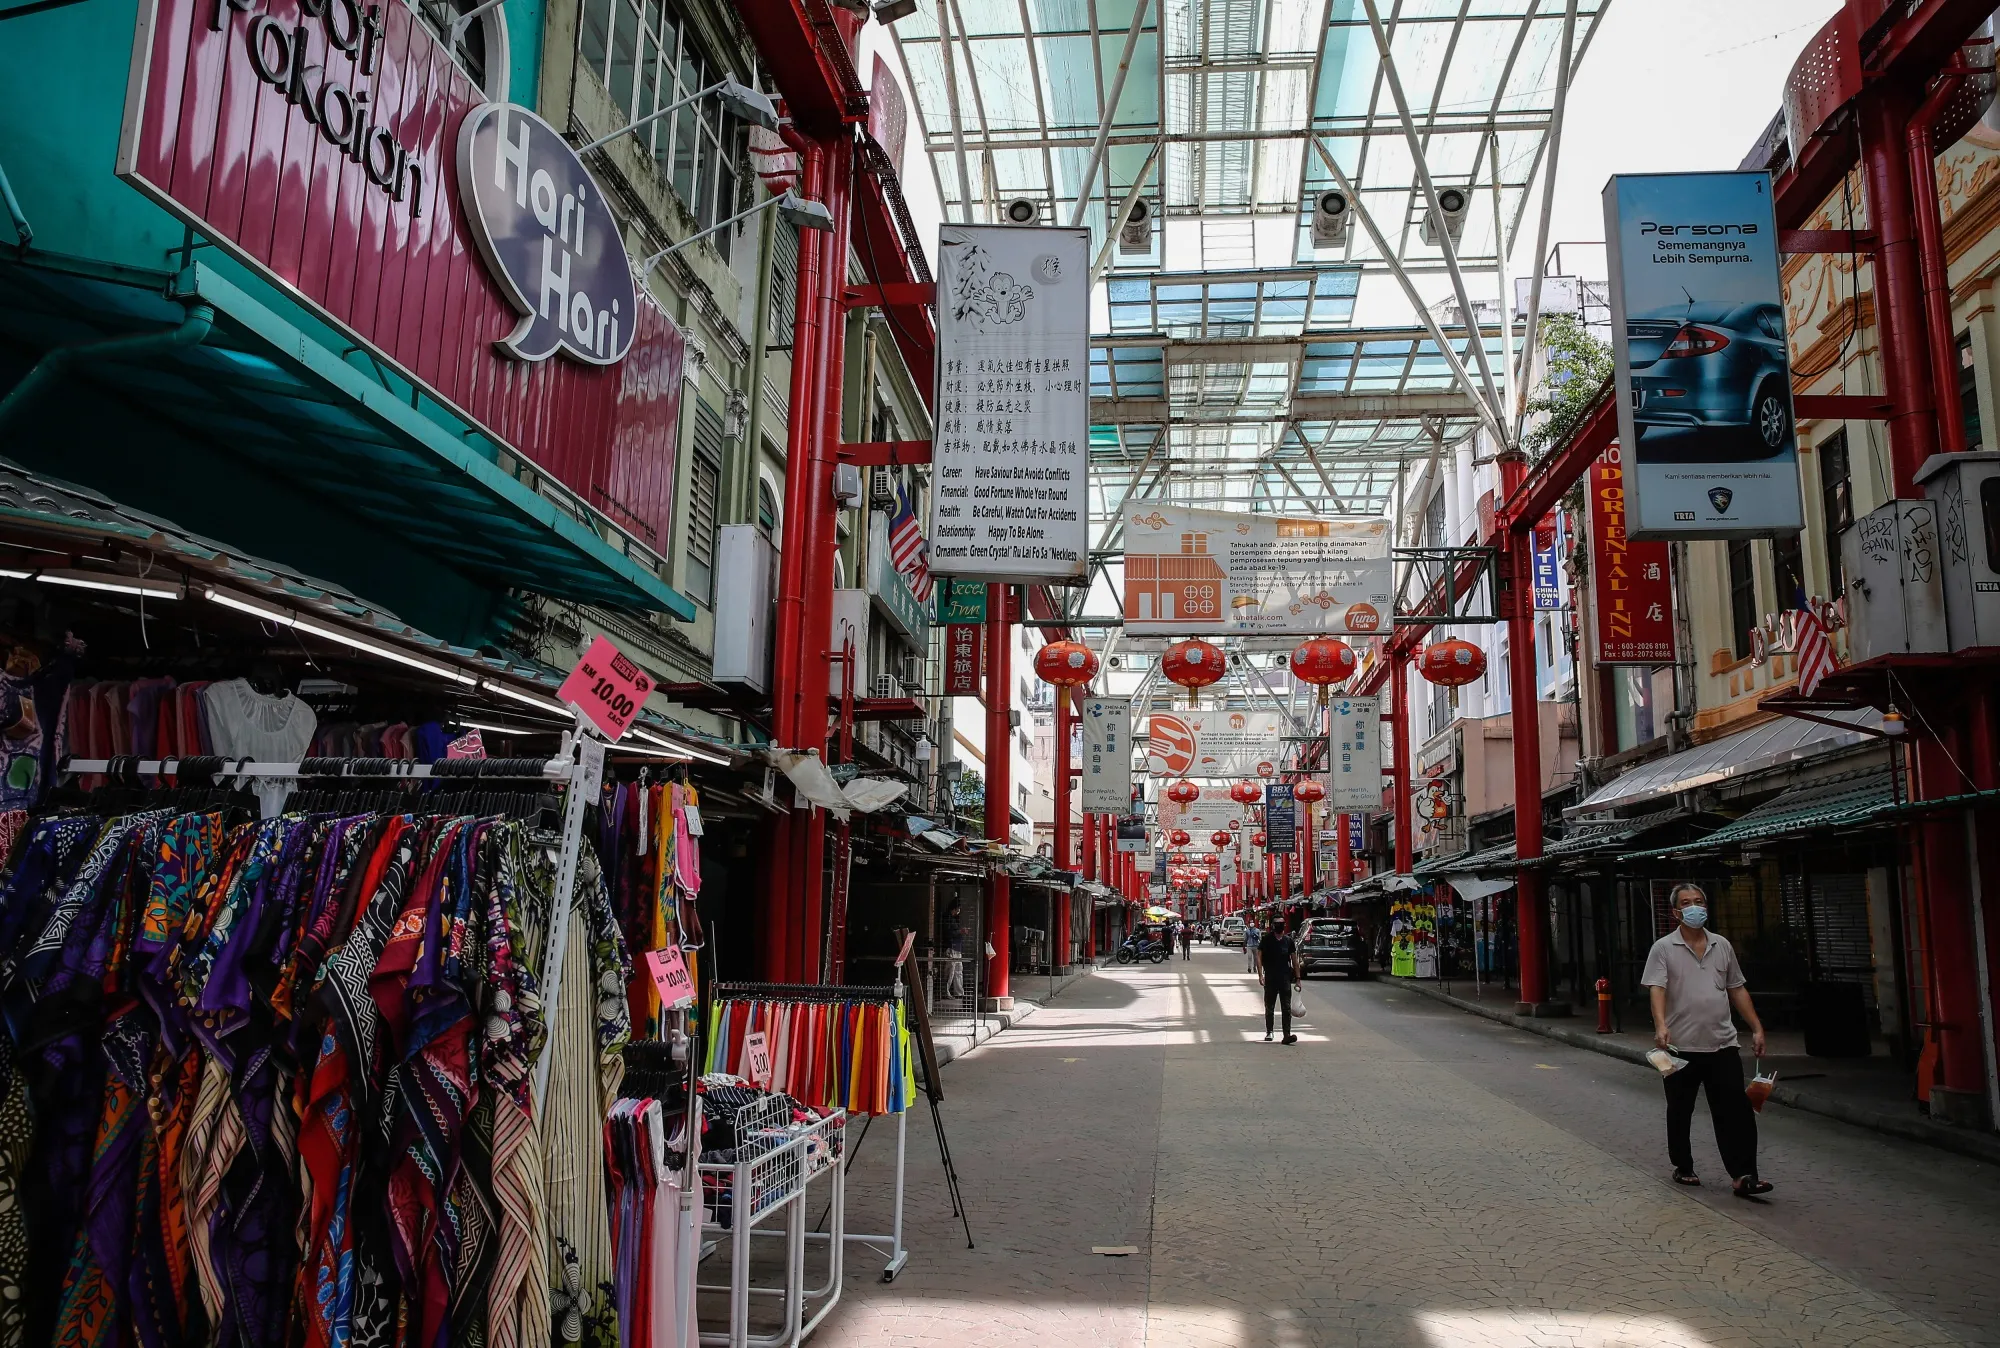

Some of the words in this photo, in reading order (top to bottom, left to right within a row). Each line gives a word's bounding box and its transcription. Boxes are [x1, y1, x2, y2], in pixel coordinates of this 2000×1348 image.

[495, 105, 586, 258] Hari
[1754, 180, 1763, 195] 1
[1641, 222, 1758, 236] Persona
[1657, 240, 1746, 252] Sememangnya
[1041, 257, 1062, 275] 猴
[1652, 253, 1686, 264] Lebih
[1688, 253, 1753, 265] Sempurna.
[539, 233, 620, 360] Hari
[942, 466, 963, 478] Career:
[975, 466, 990, 479] Have
[990, 466, 1012, 479] Saviour
[1013, 466, 1024, 479] But
[1024, 467, 1044, 480] Avoids
[1044, 467, 1070, 480] Conflicts
[940, 485, 969, 498] Financial:
[974, 485, 990, 499] Good
[991, 486, 1014, 499] Fortune
[1015, 486, 1034, 500] Whole
[1034, 487, 1048, 500] Year
[1048, 487, 1068, 501] Round
[939, 504, 961, 518] Health:
[973, 505, 981, 518] Be
[981, 505, 1004, 520] Careful,
[1005, 506, 1024, 519] Watch
[1025, 506, 1037, 519] Out
[1037, 507, 1048, 520] For
[1048, 507, 1077, 521] Accidents
[1675, 512, 1694, 520] TRTA
[937, 524, 976, 541] Relationship:
[988, 525, 1008, 541] Happy
[1009, 525, 1017, 538] To
[1017, 525, 1026, 539] Be
[1026, 526, 1044, 539] Alone
[1600, 487, 1629, 591] ORIENTAL
[935, 544, 968, 558] Ornament:
[970, 544, 988, 558] Green
[1012, 545, 1021, 558] Ru
[1022, 545, 1032, 559] Lai
[1032, 546, 1040, 559] Fo
[1040, 546, 1048, 559] Sa
[1300, 541, 1328, 549] Petaling
[1327, 548, 1348, 556] kilang
[1642, 562, 1663, 622] 酒店
[1976, 582, 1999, 591] TRTA
[948, 600, 981, 617] Inn
[1232, 614, 1284, 622] tunetalk.com
[1348, 611, 1377, 628] Tune
[1609, 599, 1633, 638] INN
[1603, 642, 1614, 650] Tel
[1621, 642, 1654, 650] 603-2026
[1654, 642, 1669, 650] 8181
[1604, 650, 1617, 658] Fax
[1621, 650, 1654, 658] 603-2072
[1654, 650, 1672, 658] 6666
[953, 627, 973, 689] 怡東旅店
[581, 663, 597, 679] RM
[591, 677, 634, 718] 10.00
[607, 711, 625, 728] EACH
[1106, 723, 1116, 753] 你健康
[1355, 720, 1365, 751] 你健康
[1092, 744, 1101, 774] 我自豪
[1342, 742, 1352, 773] 我自豪
[1271, 785, 1290, 793] BBX
[666, 968, 687, 988] 10.00
